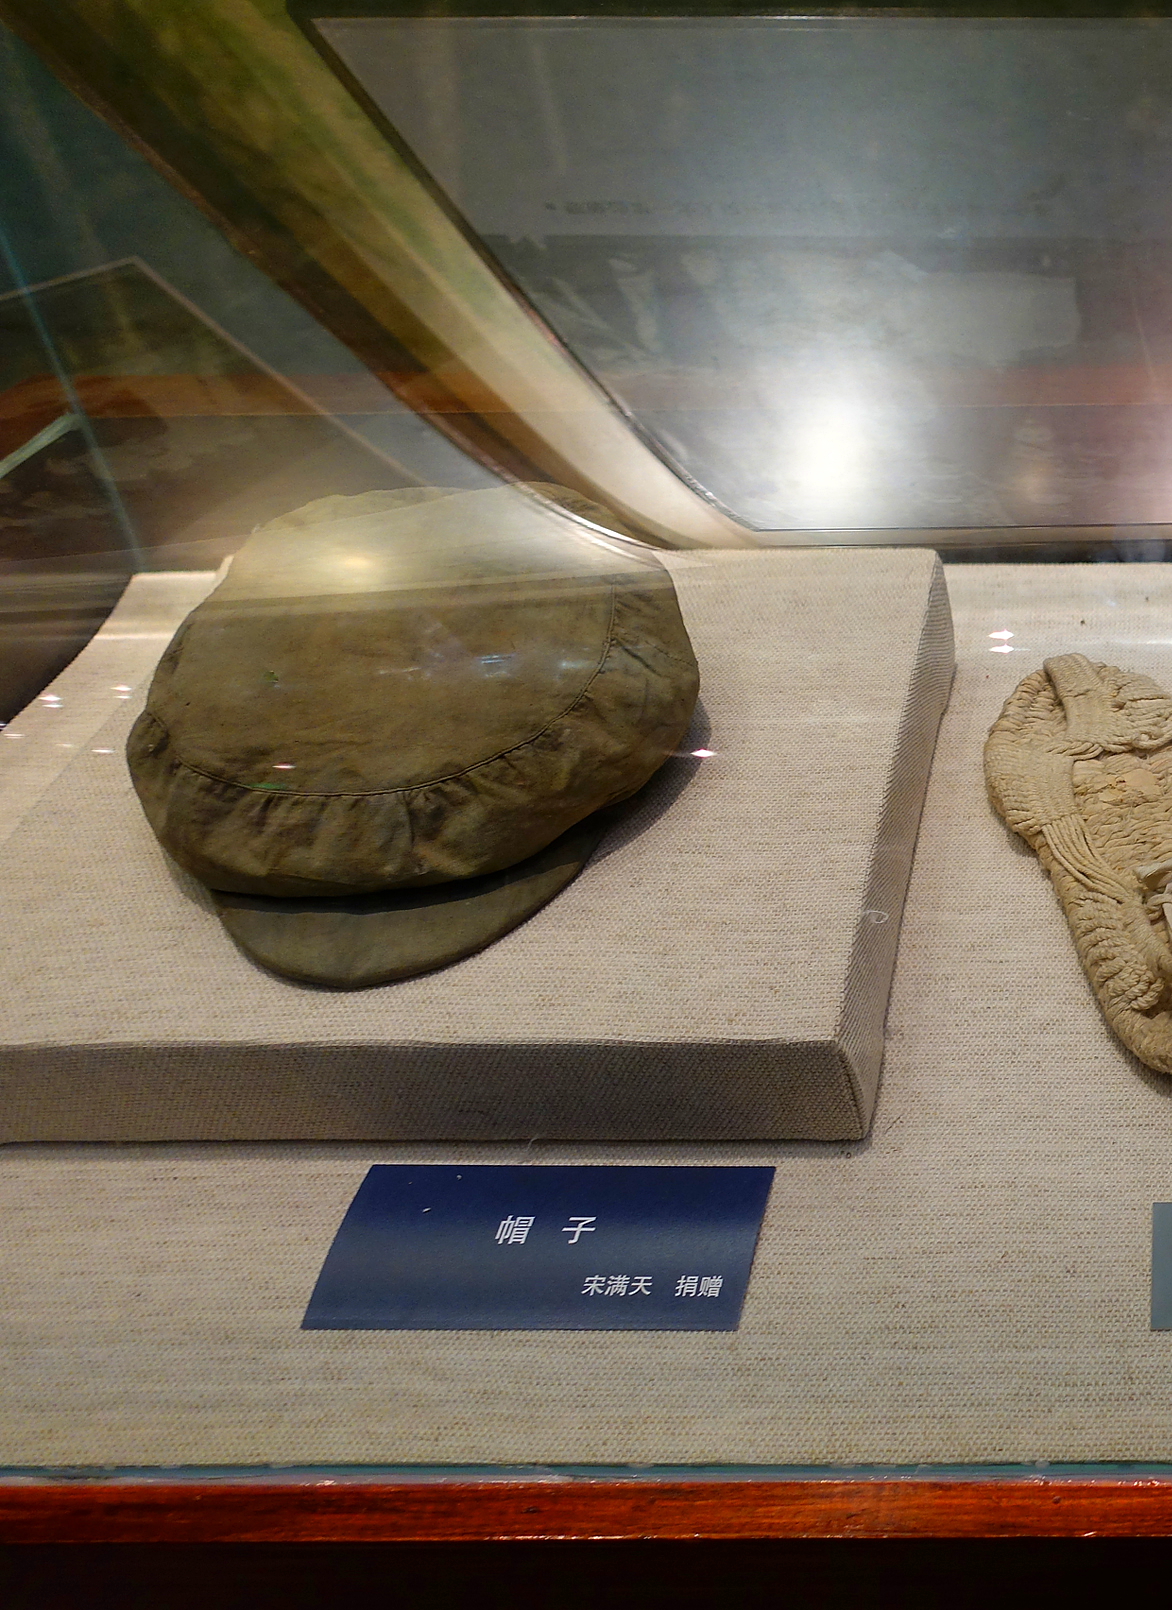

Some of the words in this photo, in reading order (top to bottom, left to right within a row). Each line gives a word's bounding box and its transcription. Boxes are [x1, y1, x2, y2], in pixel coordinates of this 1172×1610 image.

[580, 1273, 654, 1297] 宋满天
[674, 1274, 724, 1297] 捐赠
